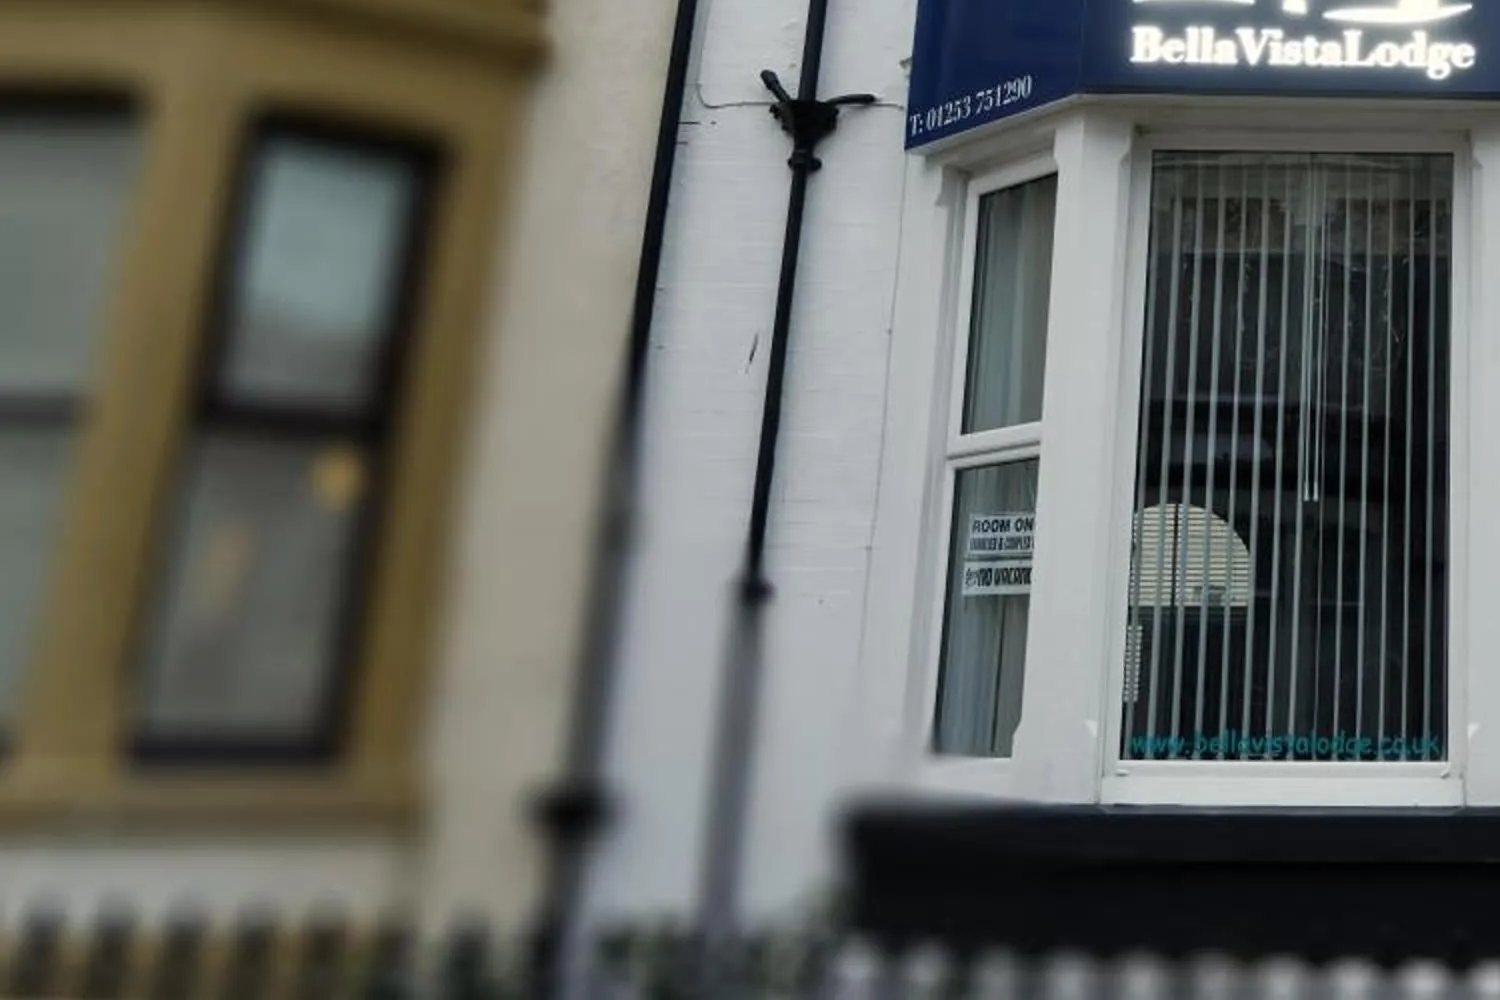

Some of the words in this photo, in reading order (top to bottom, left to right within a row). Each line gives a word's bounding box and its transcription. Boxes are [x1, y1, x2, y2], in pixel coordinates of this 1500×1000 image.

[1130, 25, 1477, 80] BellaVistaLodge
[910, 112, 923, 137] T:
[925, 95, 971, 131] 01253
[974, 74, 1033, 115] 751290
[972, 518, 1010, 533] ROOM
[1014, 517, 1034, 532] ON
